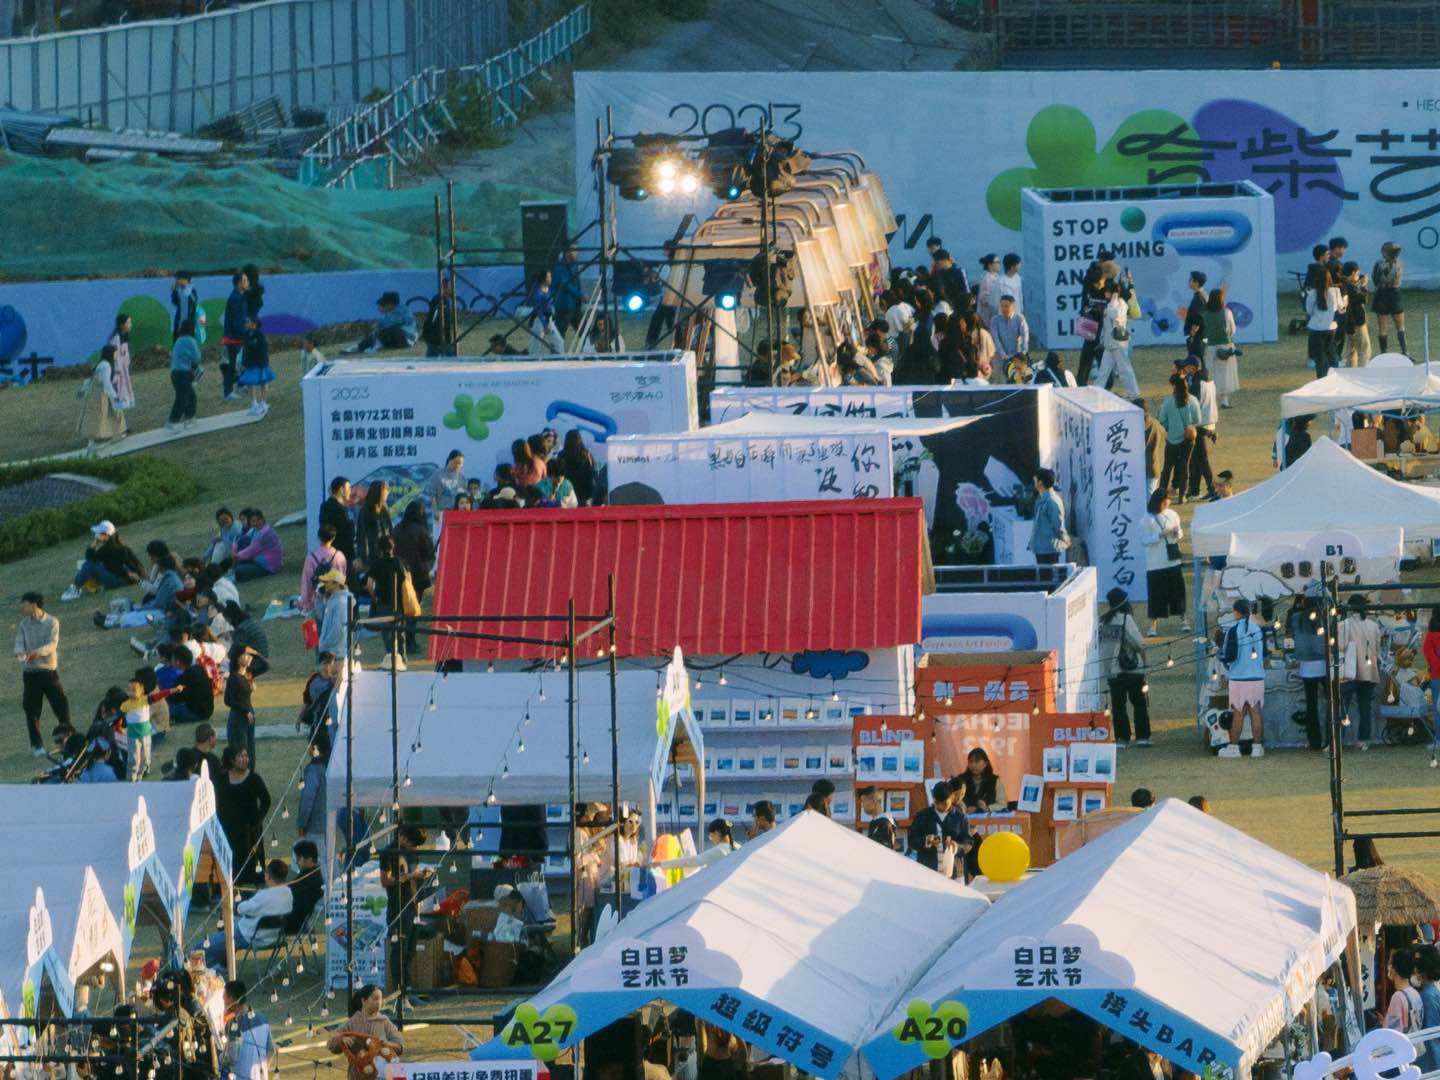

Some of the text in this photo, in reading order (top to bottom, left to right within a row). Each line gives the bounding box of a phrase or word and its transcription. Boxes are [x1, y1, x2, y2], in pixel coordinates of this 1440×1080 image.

[1052, 218, 1109, 237] STOP
[1054, 241, 1165, 262] DREAMING
[331, 386, 370, 401] 2023
[1325, 544, 1344, 556] B1
[860, 729, 914, 743] BLIND
[1054, 727, 1109, 741] BLIND
[620, 946, 689, 966] 白日梦
[1014, 946, 1082, 965] 白日梦
[620, 968, 689, 988] 艺术节
[1014, 968, 1082, 987] 艺术节
[507, 1020, 573, 1046] A27
[710, 992, 834, 1069] 超级符号
[899, 1017, 968, 1042] A20
[1100, 990, 1217, 1064] 接头BAR
